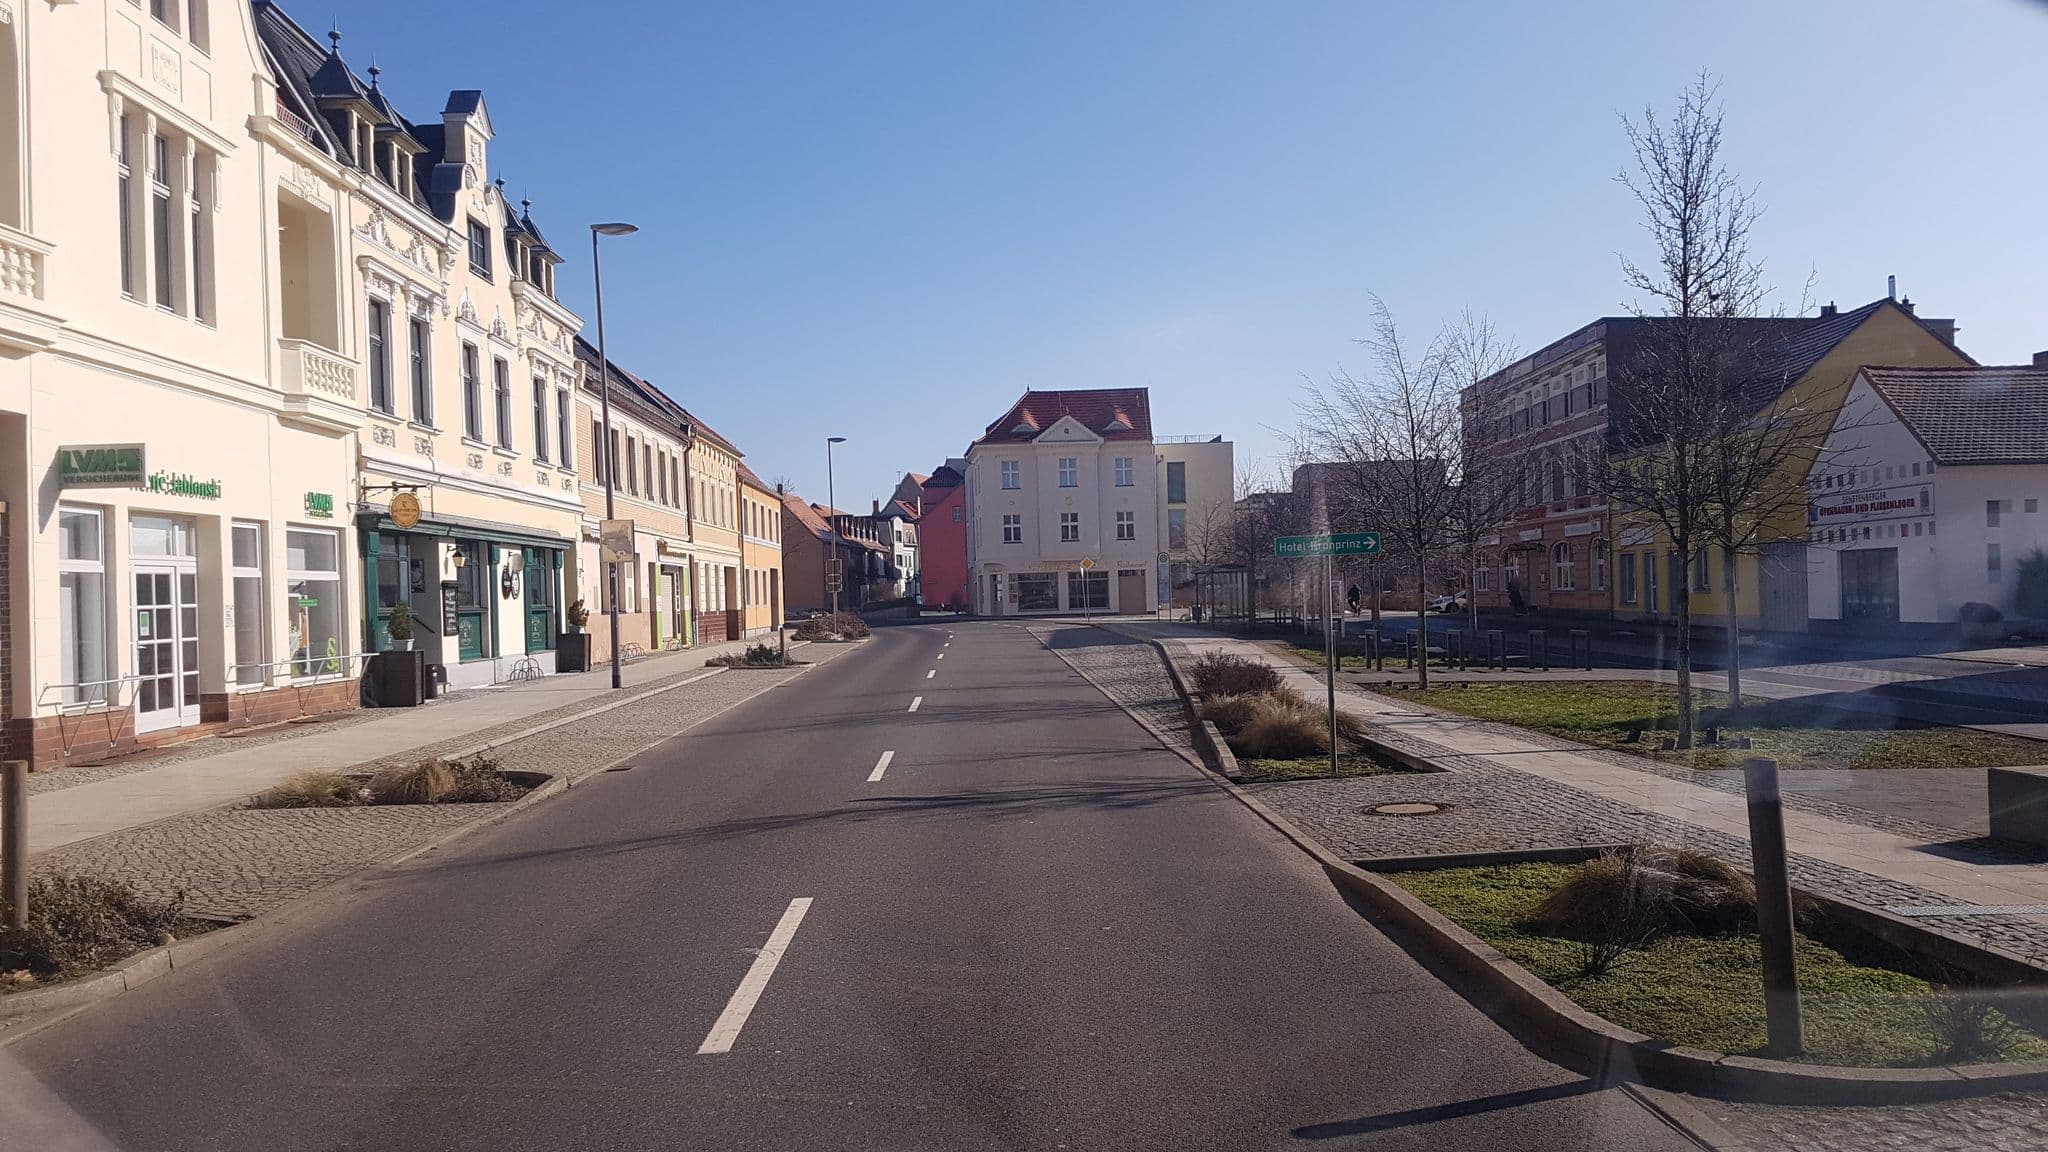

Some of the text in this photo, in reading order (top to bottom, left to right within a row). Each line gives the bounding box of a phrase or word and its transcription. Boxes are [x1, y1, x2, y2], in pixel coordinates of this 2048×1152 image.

[62, 448, 117, 473] LVM
[63, 473, 142, 483] VERSICHERUNG
[1279, 540, 1361, 552] Hotel Kronprinz
